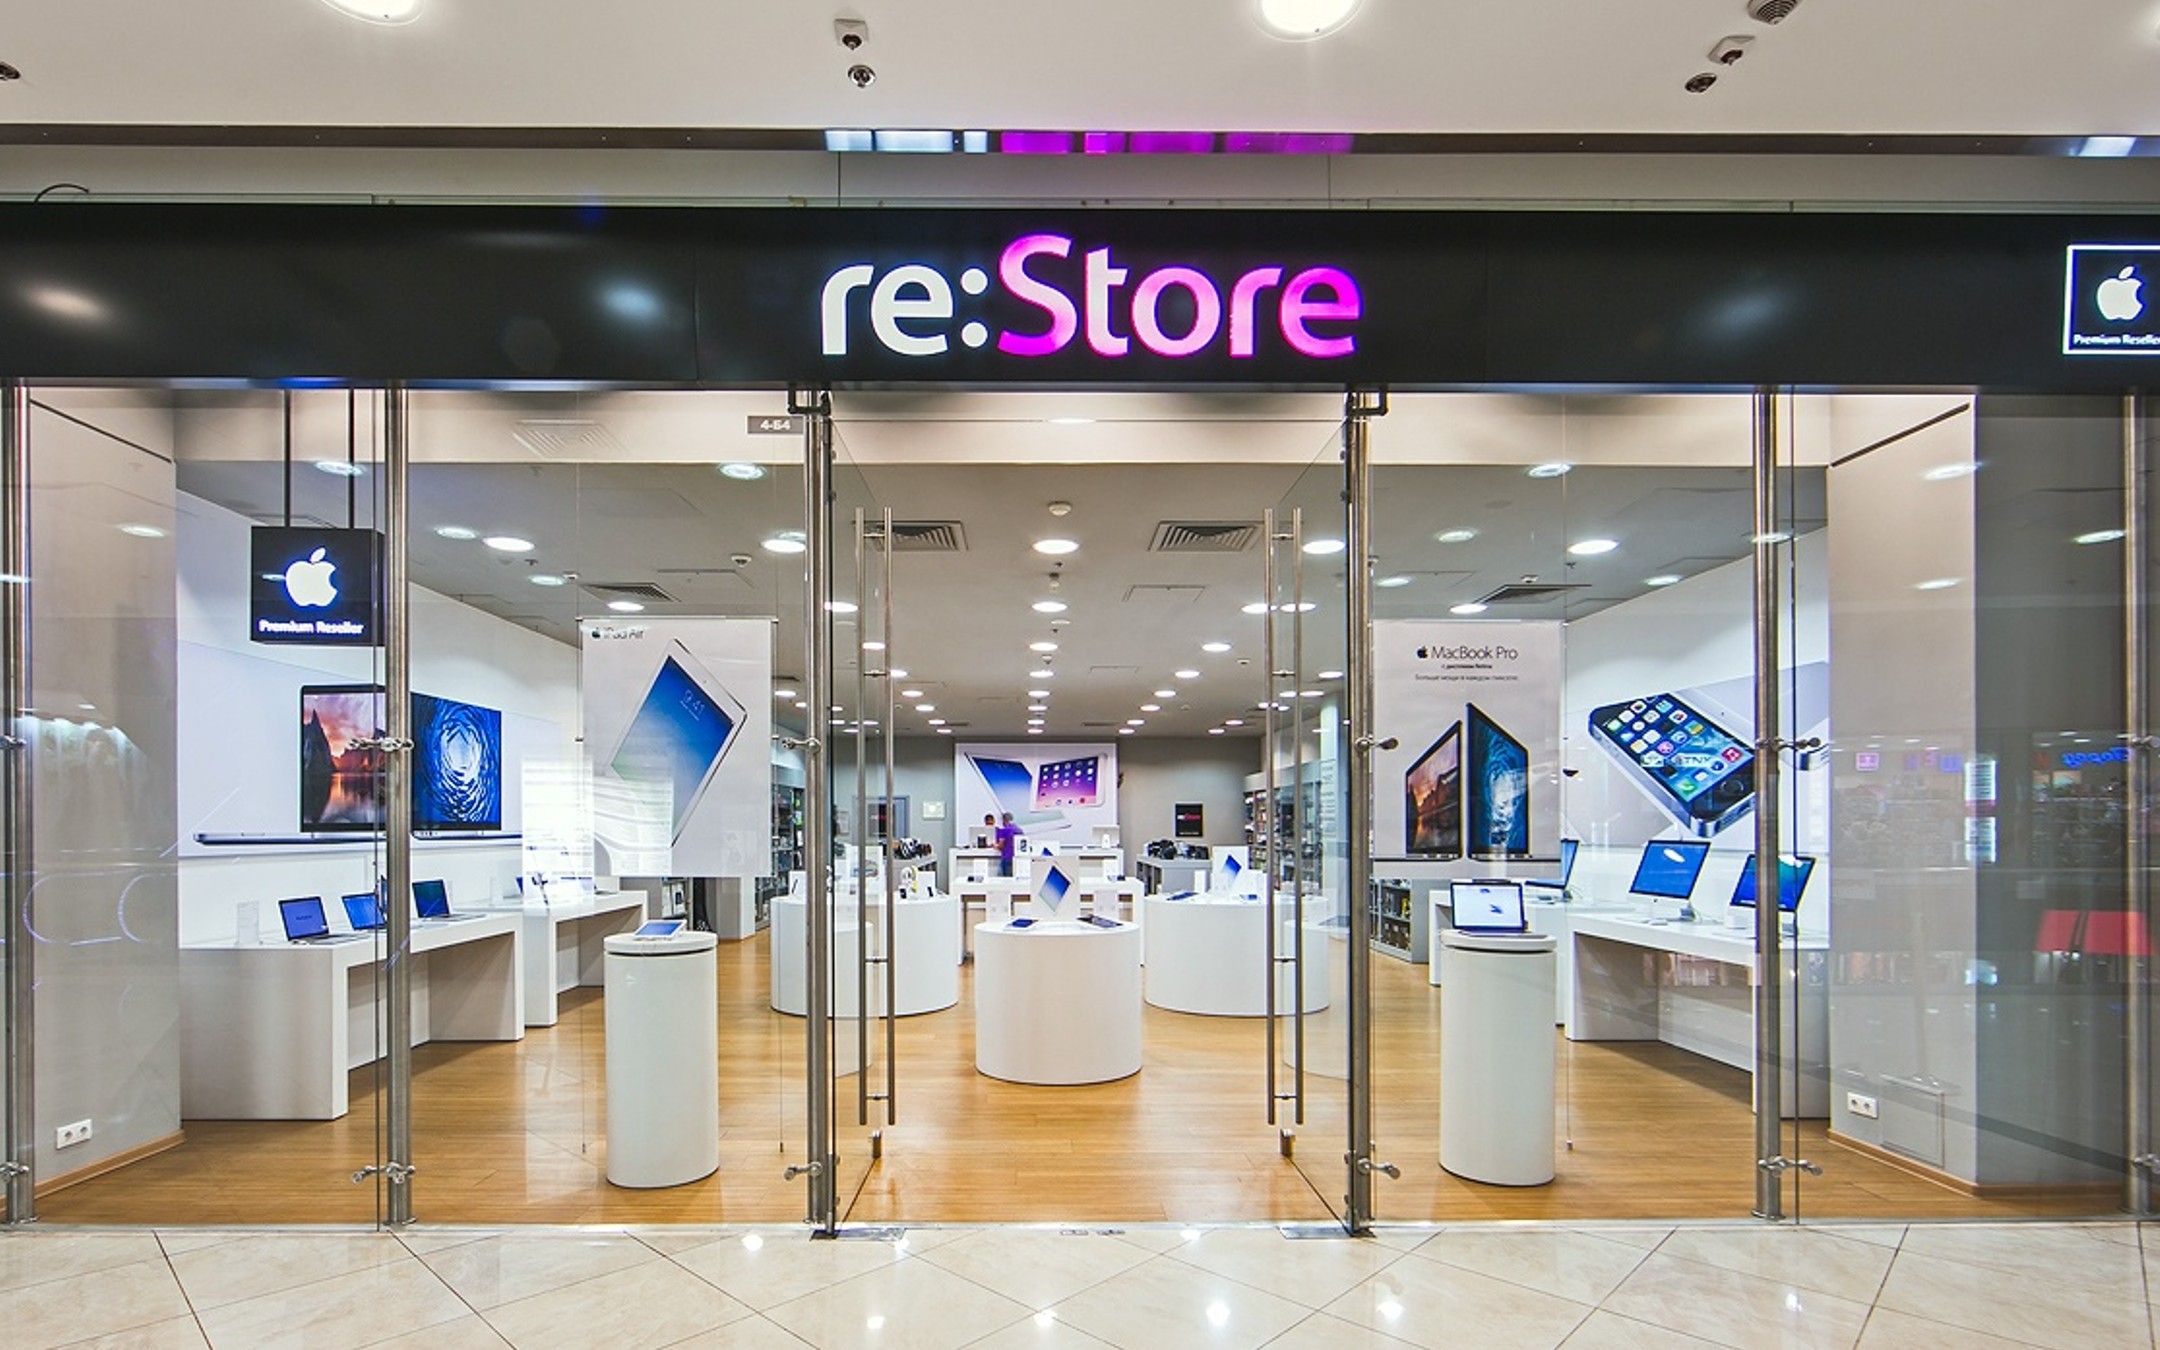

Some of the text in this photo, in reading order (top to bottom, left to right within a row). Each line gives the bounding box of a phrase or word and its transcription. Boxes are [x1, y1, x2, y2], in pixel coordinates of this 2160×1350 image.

[820, 233, 1362, 357] re:Store
[2073, 333, 2160, 345] Premium Reselle
[258, 619, 364, 634] Premium Reseller
[1431, 645, 1518, 660] MacBook Pro
